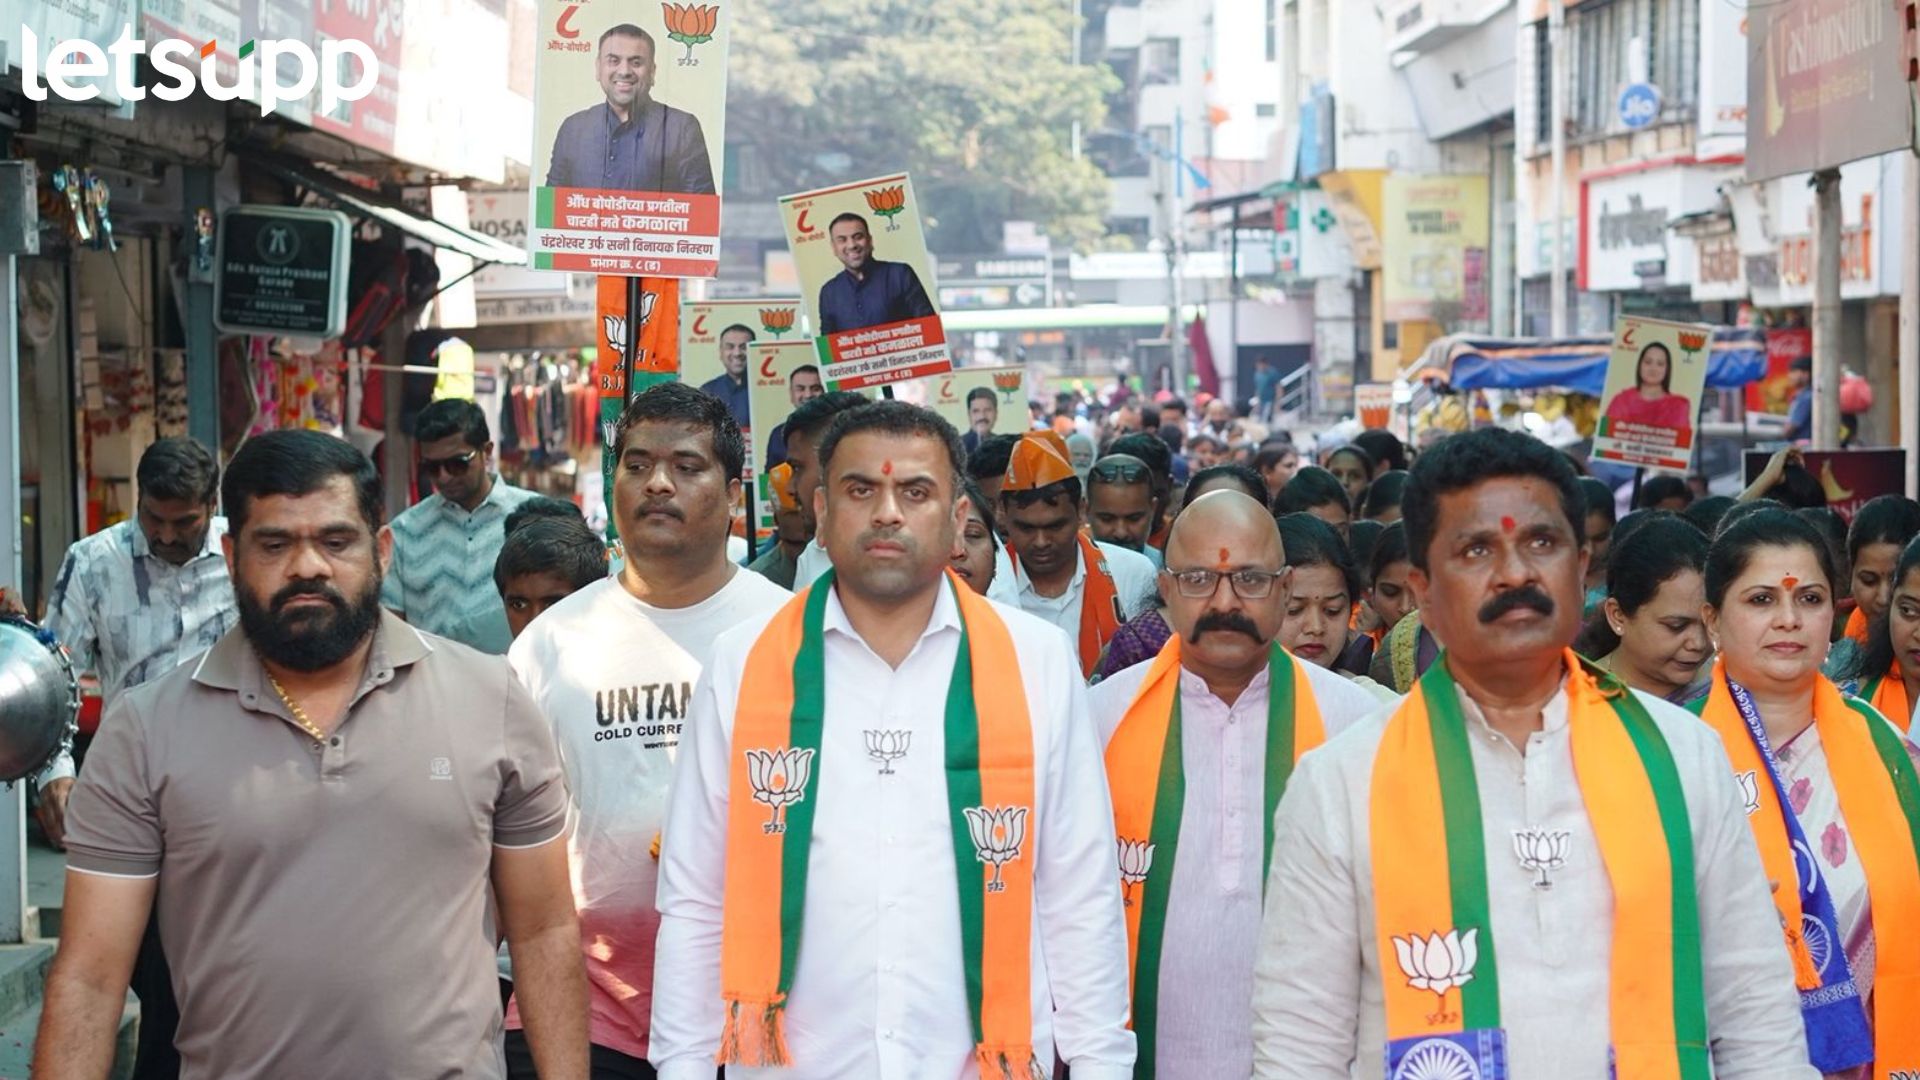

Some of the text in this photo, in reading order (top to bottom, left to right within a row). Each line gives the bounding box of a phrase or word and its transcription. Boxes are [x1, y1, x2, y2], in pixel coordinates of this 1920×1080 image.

[566, 213, 690, 232] चारही मते कमळाला
[541, 234, 585, 249] चंद्रशेखर
[606, 238, 631, 252] सनी
[633, 238, 675, 253] विनायक
[594, 727, 632, 742] COLD
